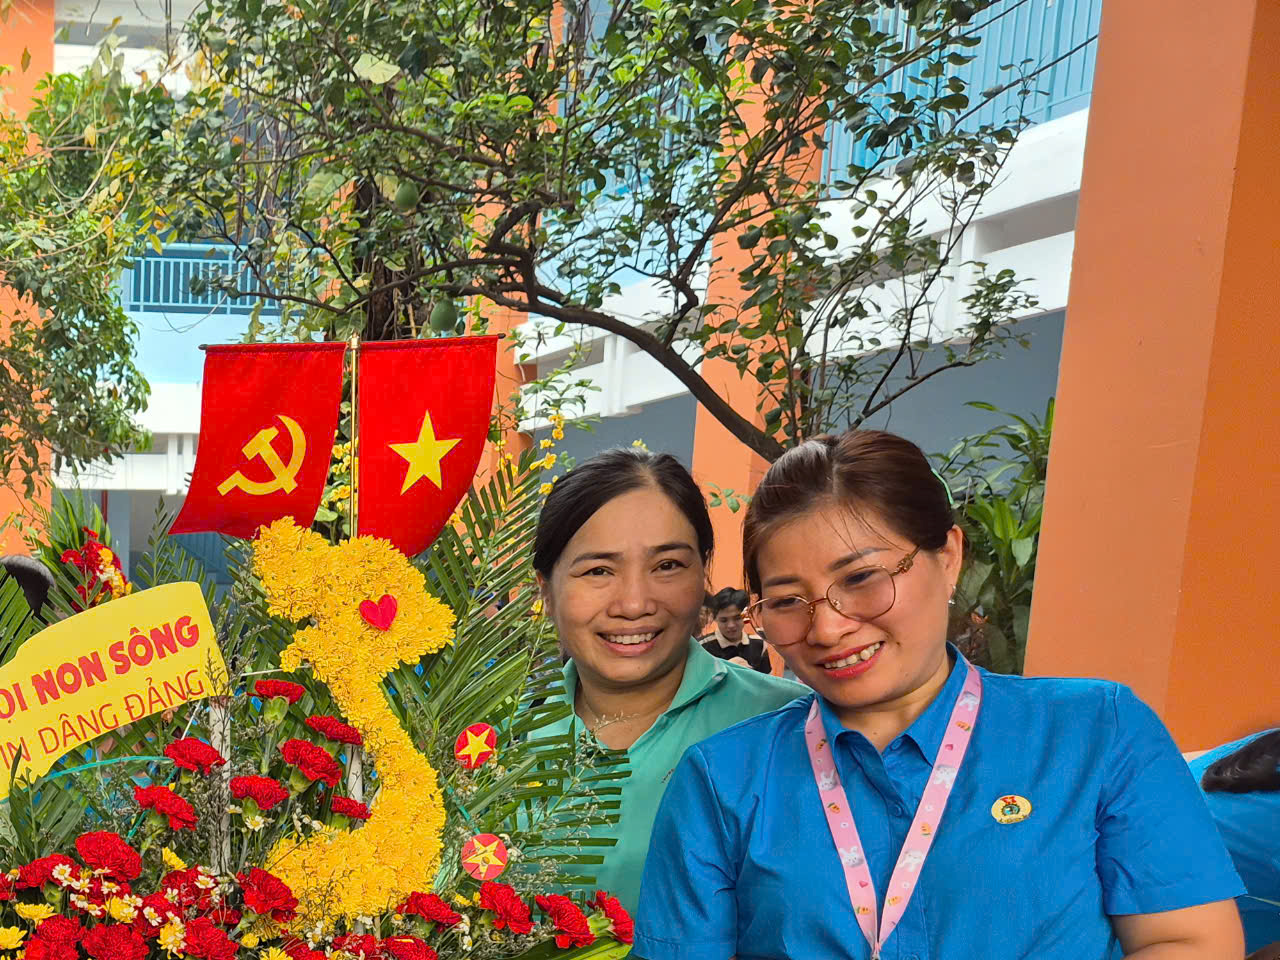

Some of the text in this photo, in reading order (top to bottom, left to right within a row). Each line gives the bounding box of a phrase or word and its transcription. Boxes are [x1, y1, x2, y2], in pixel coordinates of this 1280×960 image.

[31, 651, 108, 706] NON
[109, 615, 200, 674] SÔNG
[39, 703, 119, 755] DÂNG
[125, 669, 205, 722] ĐẢNG
